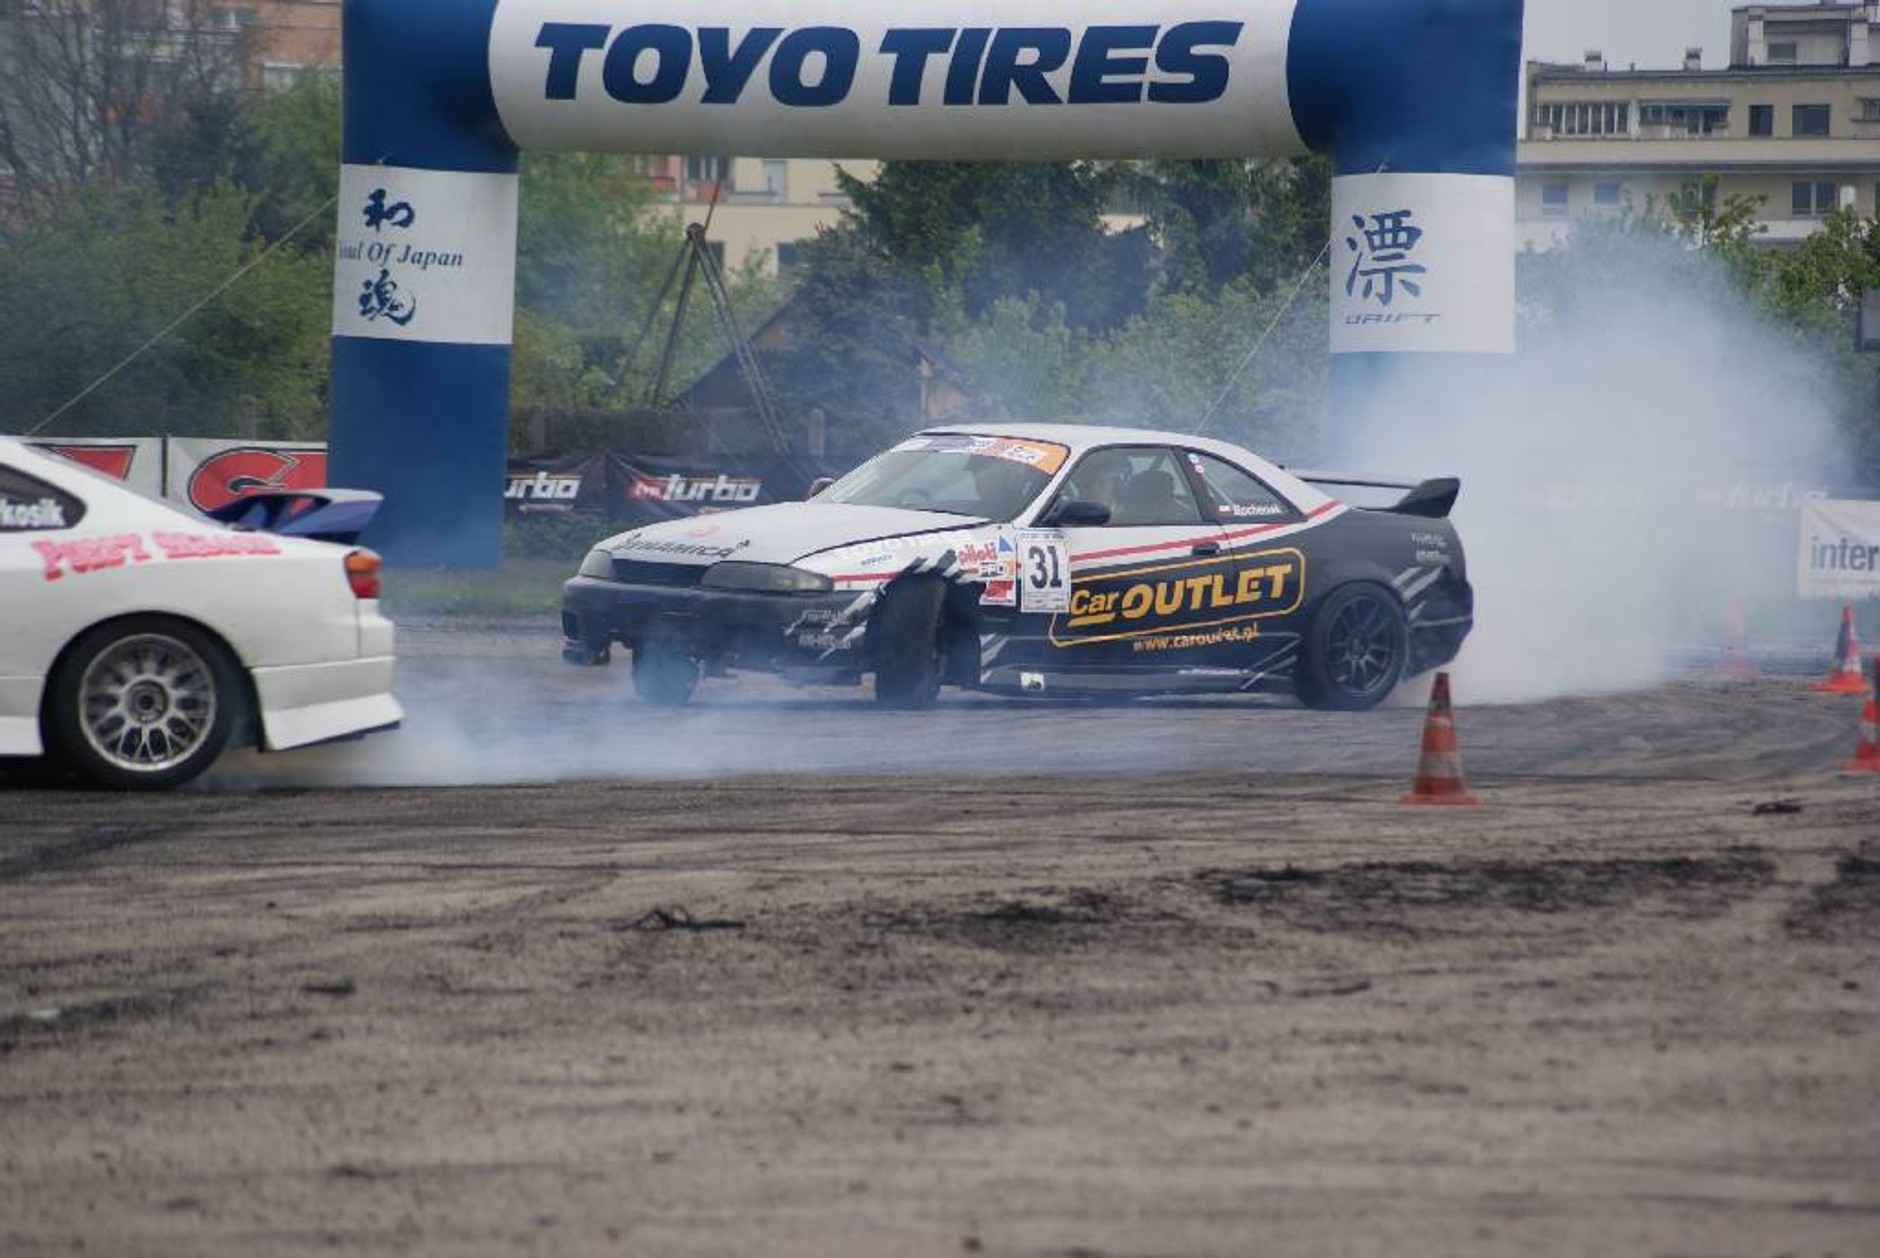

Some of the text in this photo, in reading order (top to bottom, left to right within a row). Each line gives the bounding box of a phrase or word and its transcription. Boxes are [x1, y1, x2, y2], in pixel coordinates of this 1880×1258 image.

[534, 20, 1244, 107] TOYO TIRES
[367, 242, 397, 267] Of
[397, 244, 462, 271] Japan
[1345, 209, 1426, 306] 漂
[1029, 545, 1063, 588] 31
[1809, 535, 1880, 571] inter
